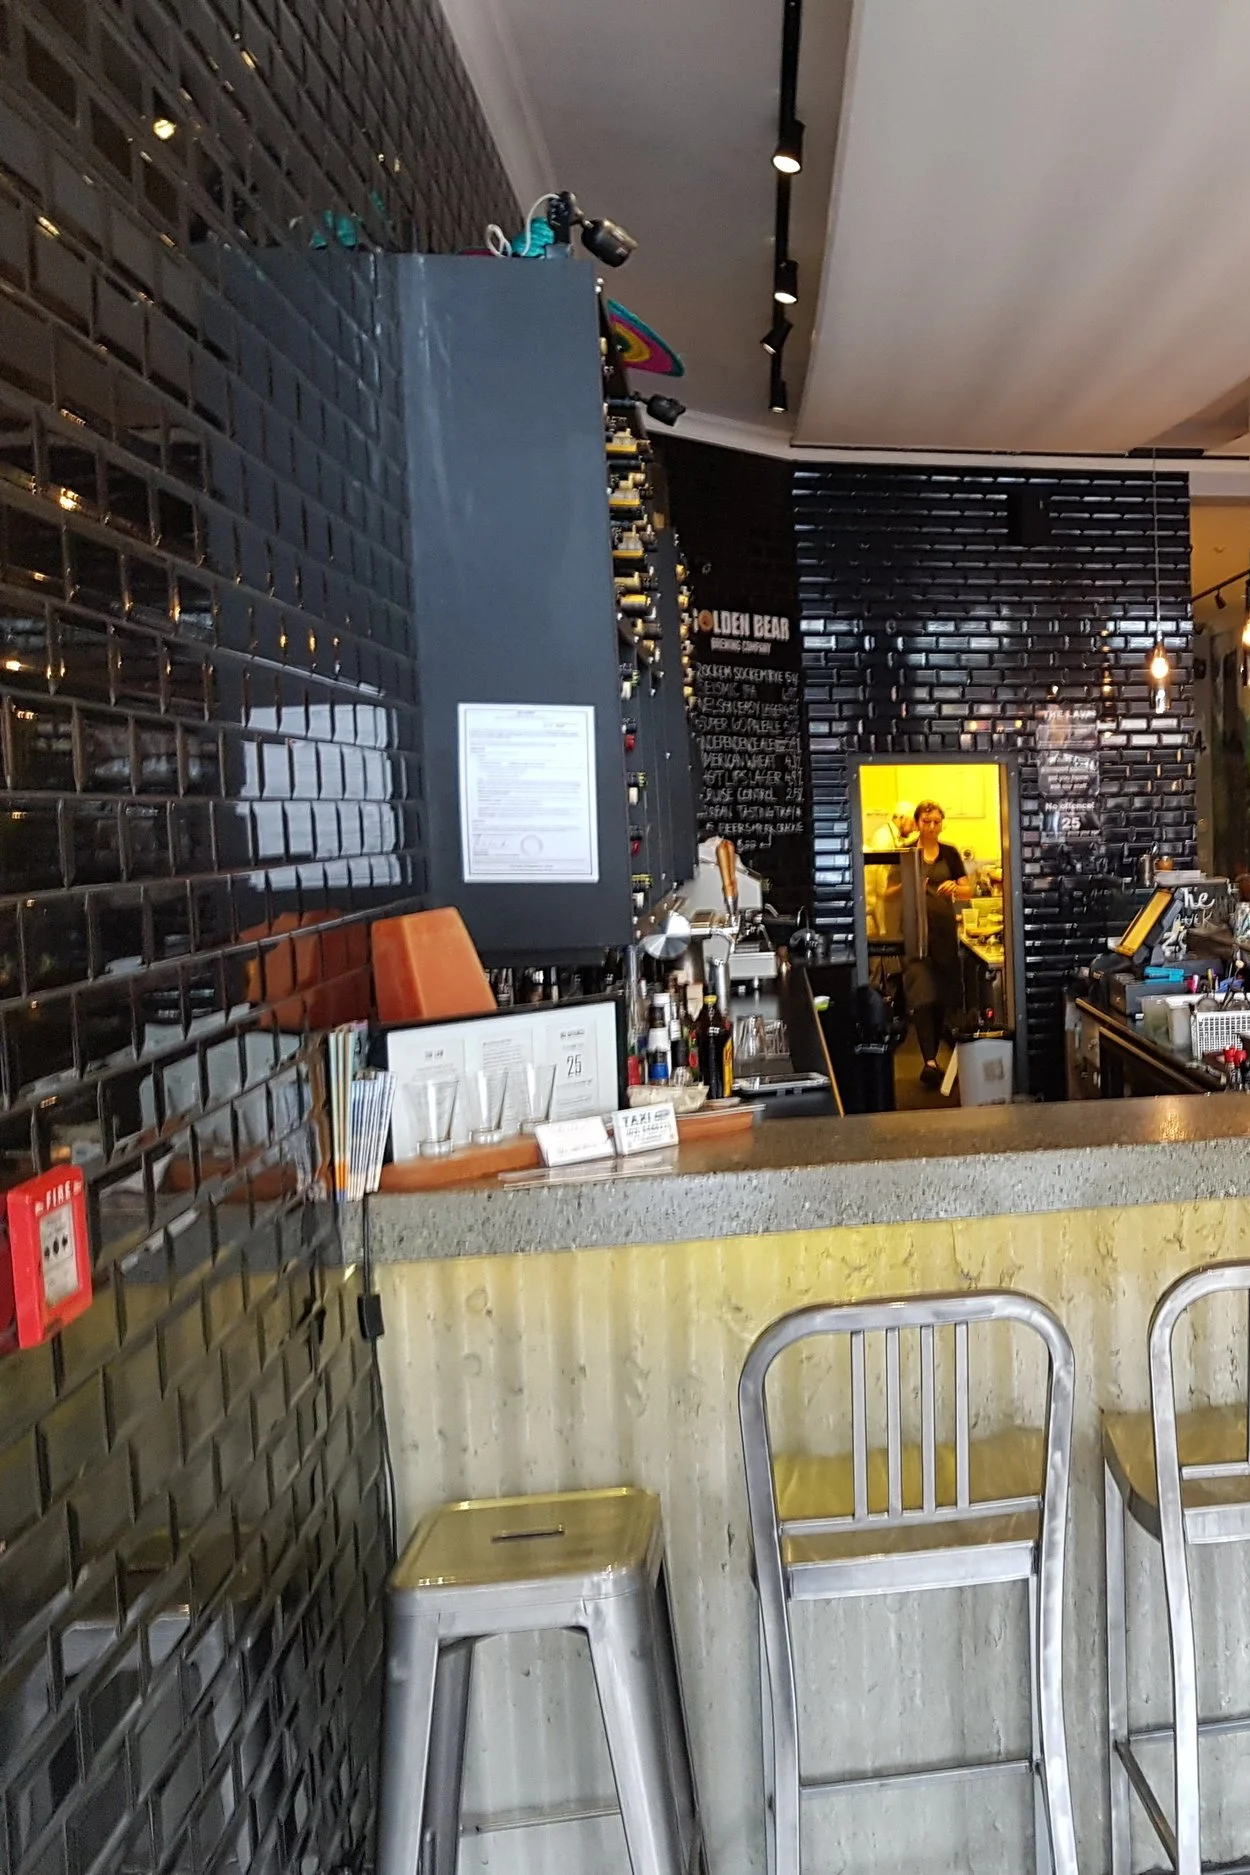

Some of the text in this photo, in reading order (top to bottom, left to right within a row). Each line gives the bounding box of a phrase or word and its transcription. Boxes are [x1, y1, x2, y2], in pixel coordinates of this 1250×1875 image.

[753, 613, 790, 641] BEAR
[1062, 817, 1081, 831] 25
[566, 1054, 583, 1078] 25
[622, 1111, 651, 1128] TAXI
[46, 1180, 71, 1211] FIRE
